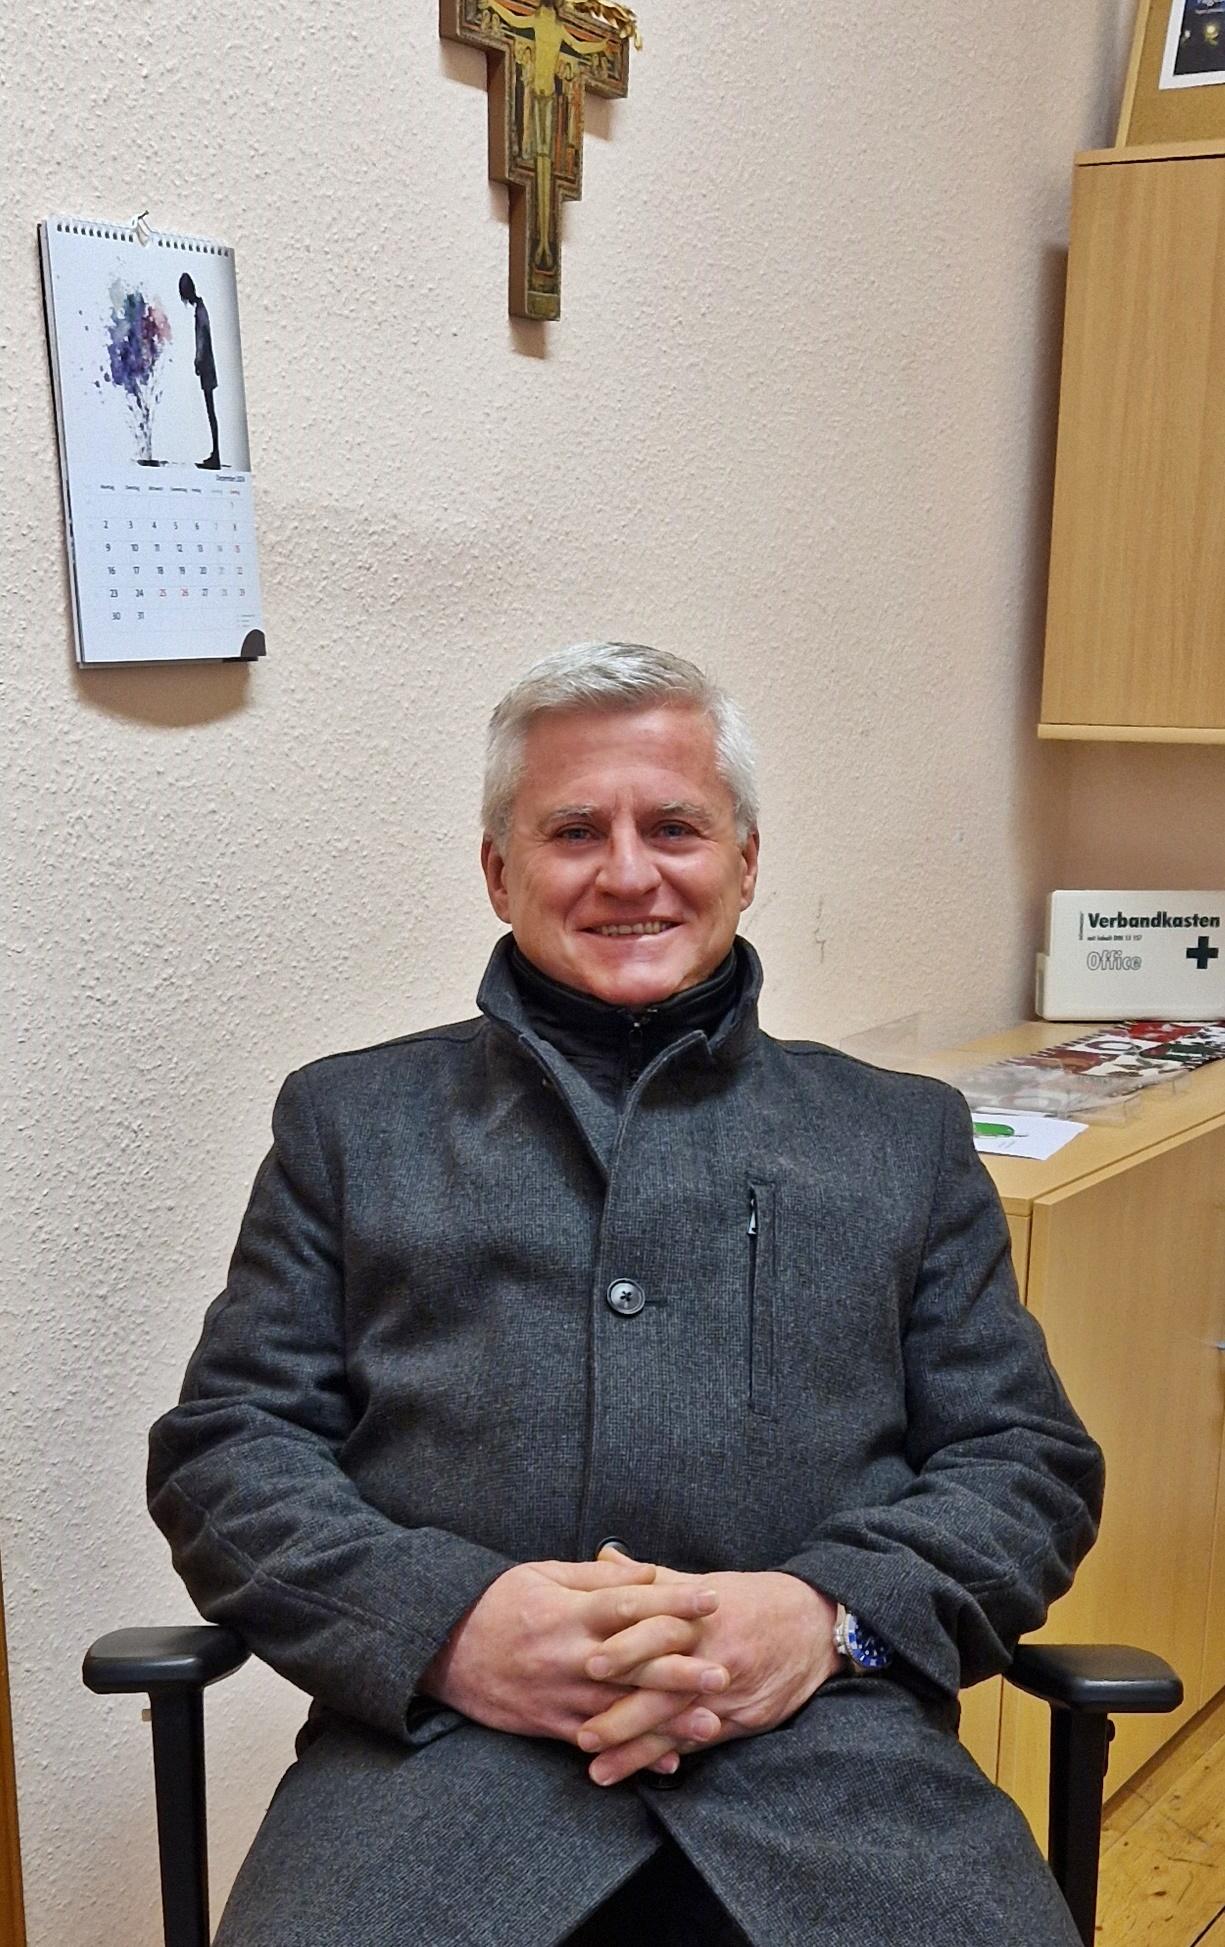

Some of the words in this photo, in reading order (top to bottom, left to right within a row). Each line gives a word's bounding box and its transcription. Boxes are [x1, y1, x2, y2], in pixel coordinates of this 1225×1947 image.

[104, 520, 108, 528] 2
[174, 522, 178, 530] 5
[106, 543, 111, 552] 9
[131, 544, 139, 552] 10
[154, 544, 160, 552] 11
[177, 544, 183, 552] 12
[198, 544, 203, 552] 13
[108, 567, 116, 575] 16
[179, 567, 185, 575] 19
[110, 589, 118, 597] 23
[136, 589, 144, 597] 24
[160, 588, 167, 597] 25
[181, 588, 189, 597] 26
[202, 588, 208, 597] 27
[112, 612, 120, 620] 30
[138, 612, 144, 620] 31
[1088, 911, 1221, 928] Verbandkasten
[1086, 950, 1142, 971] Office
